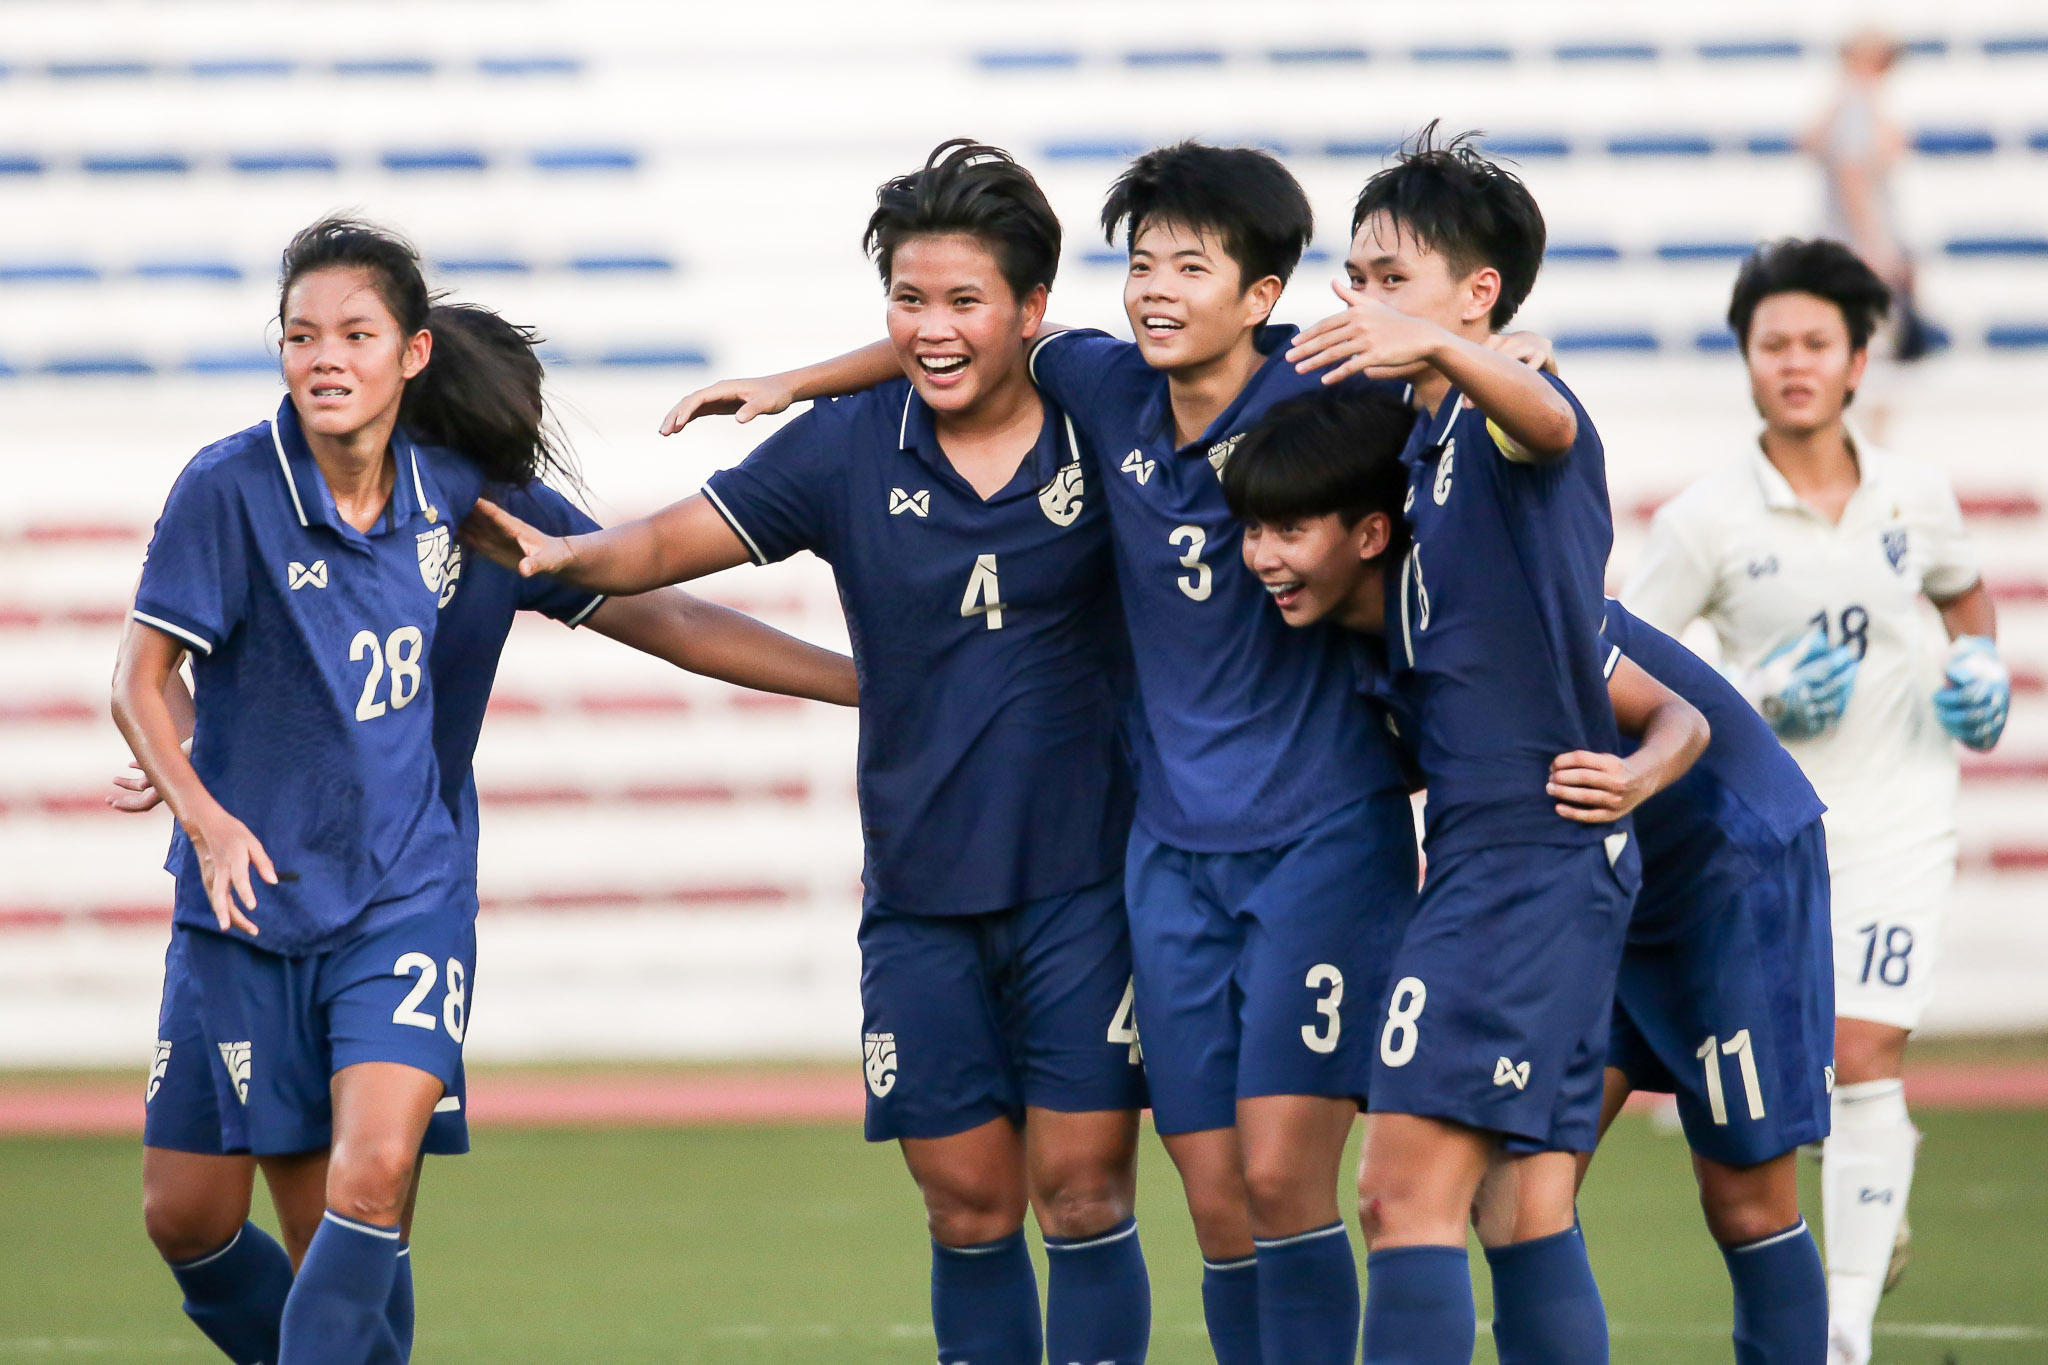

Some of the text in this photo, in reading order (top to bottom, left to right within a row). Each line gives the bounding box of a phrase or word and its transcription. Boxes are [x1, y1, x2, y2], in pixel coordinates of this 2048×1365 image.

[960, 553, 1008, 630] 4
[1168, 525, 1212, 601] 3
[348, 625, 423, 722] 28
[391, 951, 465, 1044] 28
[1857, 922, 1913, 988] 18
[1106, 973, 1141, 1066] 4
[1300, 963, 1345, 1054] 3
[1379, 976, 1427, 1067] 8
[1696, 1029, 1766, 1126] 11
